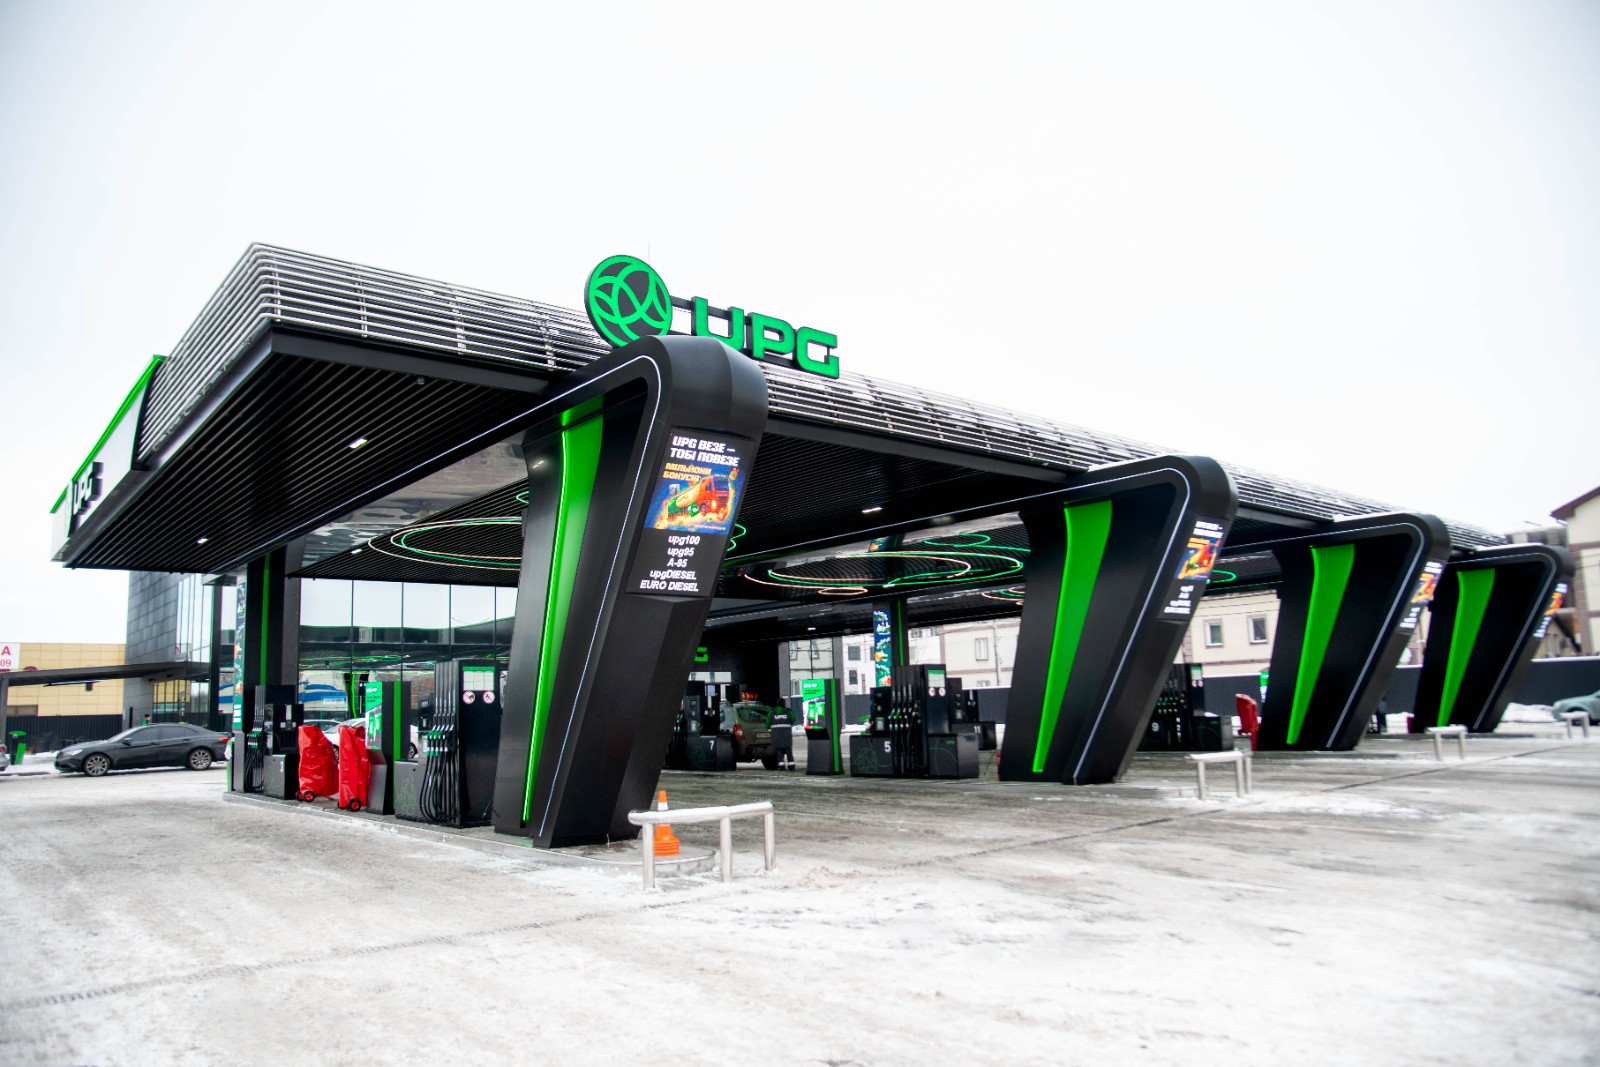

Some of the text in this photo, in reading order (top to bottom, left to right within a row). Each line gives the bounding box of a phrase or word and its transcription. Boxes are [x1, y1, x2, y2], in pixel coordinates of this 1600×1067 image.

[692, 296, 839, 379] UPG
[672, 436, 697, 449] UPG
[698, 440, 726, 453] ВЕЗЕ
[670, 447, 740, 466] ТОБІ ПОВЕЗЕ
[668, 535, 700, 545] upg100
[667, 547, 695, 557] upg95
[667, 558, 688, 567] A-95
[650, 570, 697, 580] upgDIESEL
[640, 580, 699, 592] EURO DIESEL
[1151, 722, 1160, 732] 9
[709, 741, 714, 750] 7
[884, 741, 891, 753] 5
